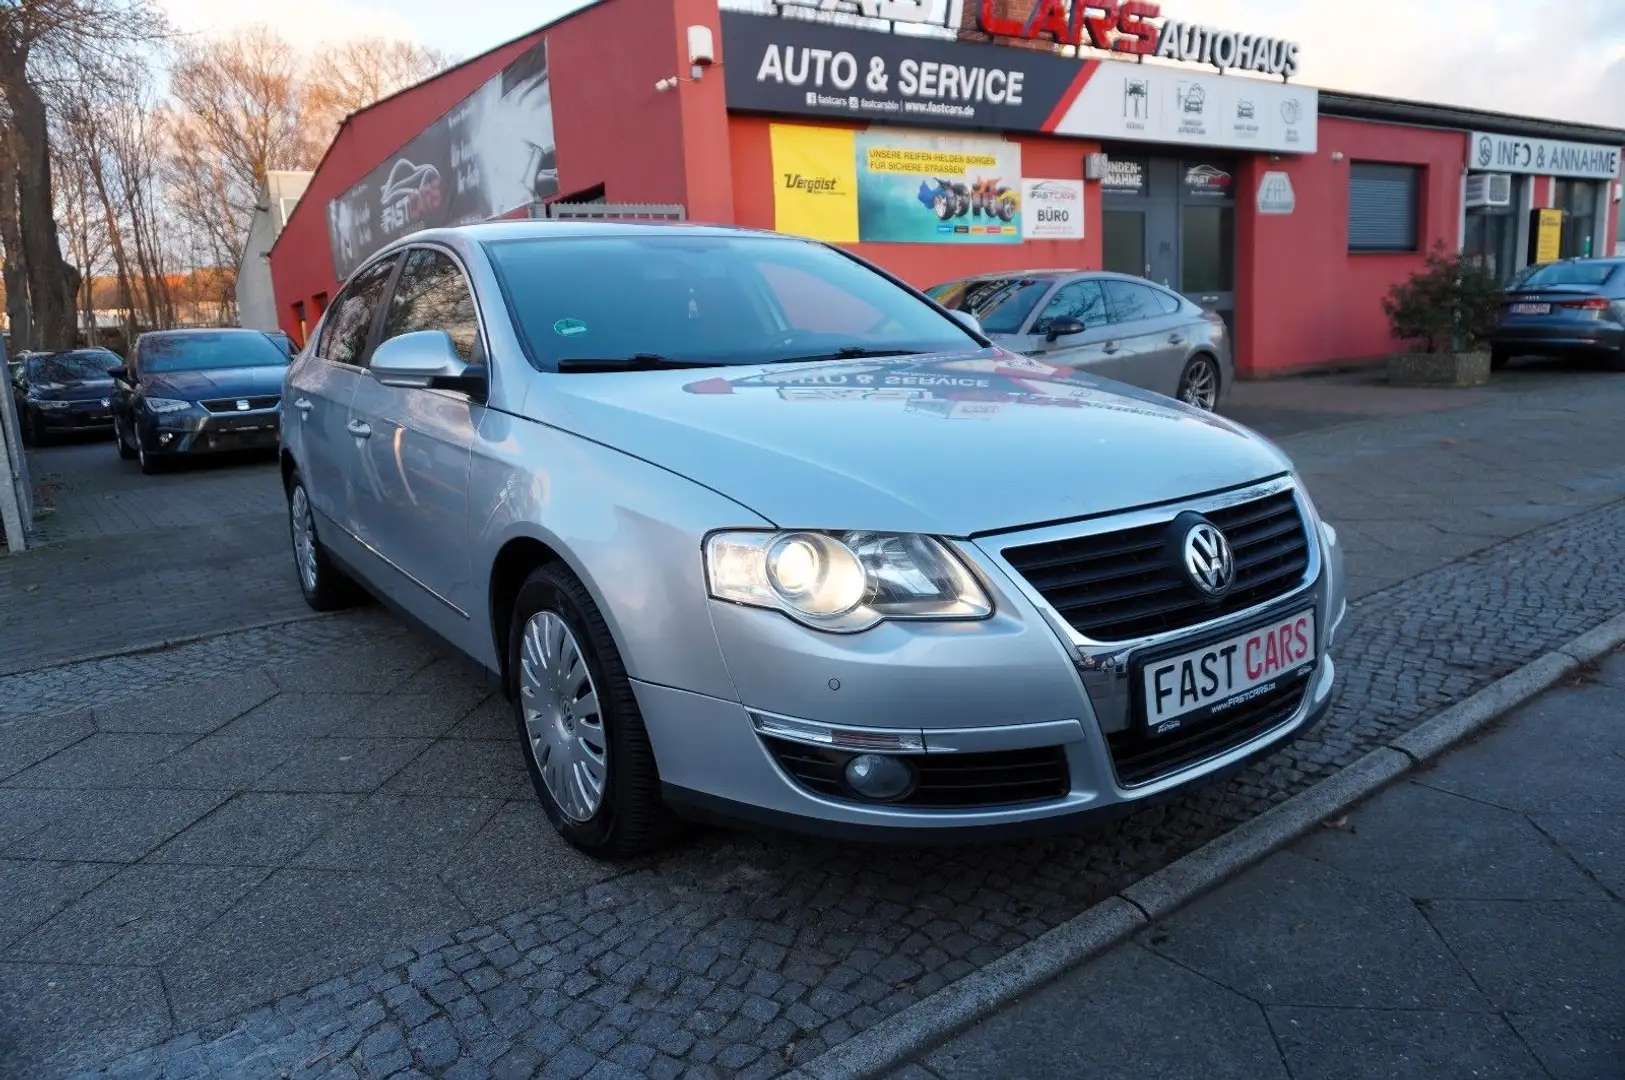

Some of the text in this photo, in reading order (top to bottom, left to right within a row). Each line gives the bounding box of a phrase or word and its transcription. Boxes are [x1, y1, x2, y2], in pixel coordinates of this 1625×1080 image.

[979, 0, 1160, 54] CARS
[1156, 19, 1300, 76] AUTOHAUS
[757, 43, 1025, 105] AUTO & SERVICE
[818, 94, 847, 106] fastcars
[905, 101, 975, 117] www.fastcars.de
[869, 149, 996, 165] UNSERE REIFEN-HELDEN SORGEN
[889, 161, 922, 172] SICHERE
[1106, 161, 1142, 173] UNDEN-
[1497, 140, 1616, 173] INFO & ANNAHME
[784, 173, 837, 193] Vergölst
[1037, 206, 1069, 222] BÜRO
[1154, 617, 1309, 714] FAST CARS
